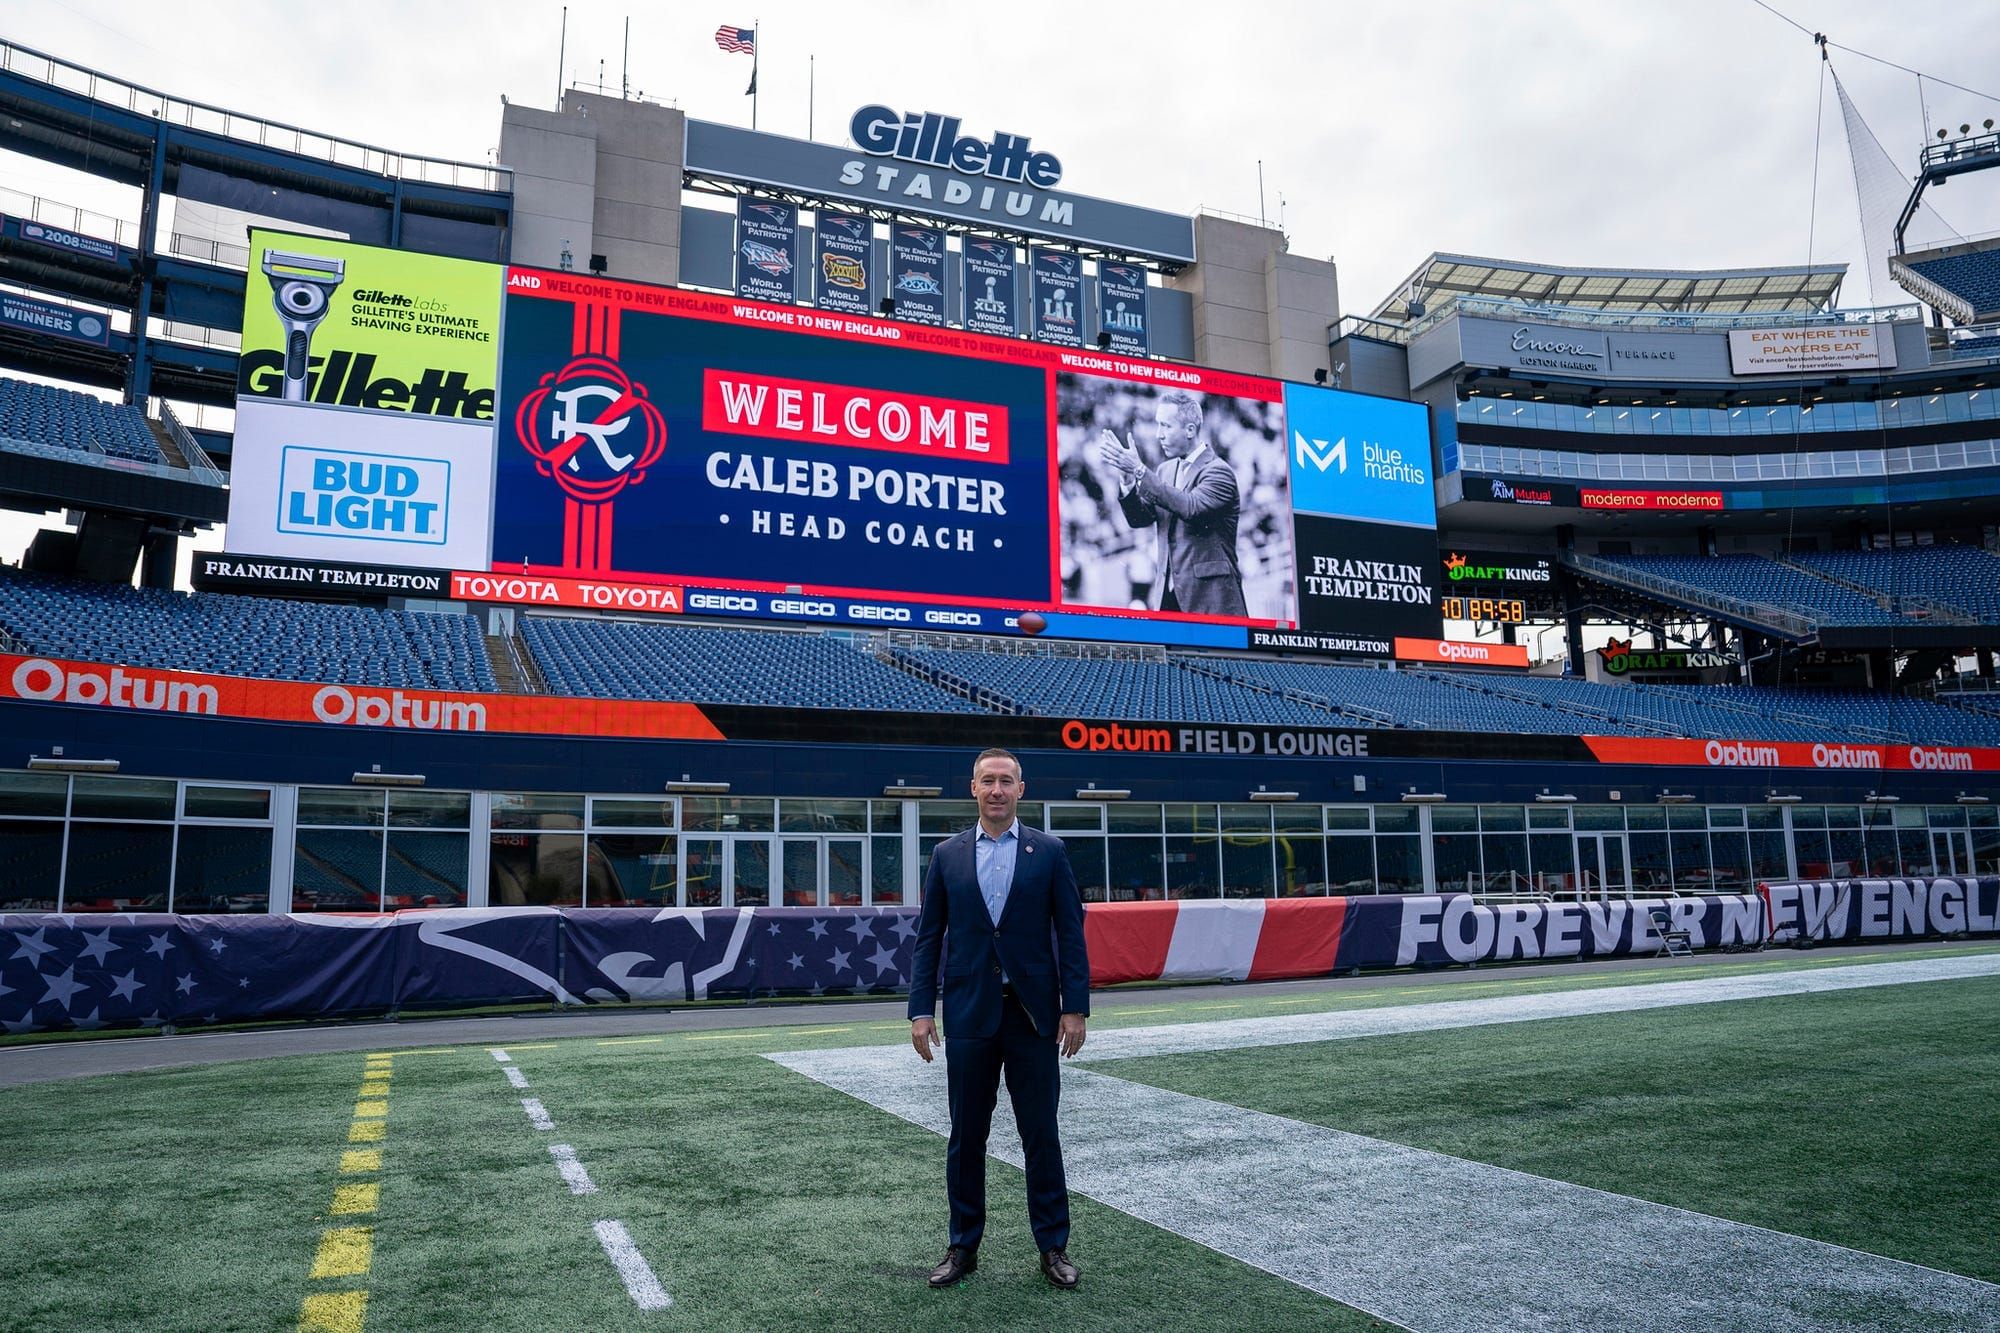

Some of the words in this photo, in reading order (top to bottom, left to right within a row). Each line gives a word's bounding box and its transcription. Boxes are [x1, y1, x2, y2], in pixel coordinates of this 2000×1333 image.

[849, 104, 1063, 189] Gillette
[839, 160, 1074, 226] STADIUM
[748, 227, 787, 240] PATRIOTS
[761, 222, 793, 234] ENGLAND
[45, 229, 80, 247] 2008
[820, 232, 837, 240] NEW
[838, 234, 869, 247] ENGLAND
[826, 240, 864, 253] PATRIOTS
[80, 244, 113, 256] CHAMPIONS
[900, 253, 937, 264] PATRIOTS
[912, 247, 942, 258] ENGLAND
[972, 265, 1007, 277] PATRIOTS
[983, 260, 1012, 271] ENGLAND
[750, 277, 782, 289] WORLD
[1035, 269, 1050, 277] NEW
[1052, 272, 1079, 282] ENGLAND
[1041, 277, 1075, 288] PATRIOTS
[546, 279, 612, 299] WELCOME
[615, 287, 632, 302] TO
[635, 292, 666, 306] NEW
[668, 295, 728, 315] ENGLAND
[740, 285, 792, 299] CHAMPIONS
[828, 289, 859, 301] WORLD
[1107, 288, 1139, 300] PATRIOTS
[1117, 283, 1144, 294] ENGLAND
[819, 297, 868, 311] CHAMPIONS
[903, 300, 933, 312] WORLD
[974, 301, 1007, 314] XLIX
[3, 306, 73, 331] WINNERS
[352, 304, 415, 320] GILLETTE'S
[420, 312, 479, 329] ULTIMATE
[733, 305, 794, 325] WELCOME
[796, 313, 814, 328] TO
[815, 317, 843, 332] NEW
[845, 321, 900, 339] ENGLAND
[895, 308, 942, 321] CHAMPIONS
[976, 312, 1005, 323] WORLD
[351, 317, 412, 333] SHAVING
[416, 324, 490, 342] EXPERIENCE
[968, 319, 1013, 333] CHAMPIONS
[1045, 323, 1073, 334] WORLD
[1037, 330, 1081, 343] CHAMPIONS
[1111, 334, 1138, 345] WORLD
[1512, 326, 1603, 358] Encore
[1752, 332, 1779, 342] EAT
[1781, 330, 1836, 340] WHERE
[1839, 328, 1870, 337] THE
[905, 330, 961, 348] WELCOME
[962, 338, 978, 351] TO
[979, 342, 1005, 355] NEW
[1007, 345, 1058, 363] ENGLAND
[1109, 342, 1146, 353] HAMPIONS
[1615, 350, 1676, 360] TERRACE
[1762, 344, 1831, 354] PLAYERS
[1834, 342, 1861, 352] EAT
[1061, 353, 1112, 372] WELCOME
[1114, 361, 1128, 374] TO
[1130, 364, 1153, 378] NEW
[1155, 369, 1201, 385] ENGLAND
[1520, 356, 1557, 368] BOSTON
[1560, 360, 1598, 371] HARBOR
[238, 349, 495, 421] Gillette
[1205, 377, 1250, 393] WELCOME
[1252, 381, 1264, 394] TO
[718, 380, 991, 453] WELCOME
[1362, 440, 1402, 465] blue
[313, 458, 419, 498] BUD
[1364, 462, 1425, 485] mantis
[706, 451, 839, 498] CALEB
[848, 465, 1007, 516] PORTER
[1493, 487, 1515, 499] AIM
[1515, 488, 1551, 500] Mutual
[1584, 492, 1645, 506] moderna
[1656, 493, 1719, 507] moderna
[289, 490, 438, 534] LIGHT
[752, 509, 846, 541] HEAD
[865, 520, 975, 552] COACH
[204, 560, 315, 582] FRANKLIN
[319, 568, 441, 592] TEMPLETON
[1312, 555, 1422, 584] FRANKLIN
[1449, 565, 1550, 582] DRAFTKINGS
[455, 576, 560, 602] TOYOTA
[578, 584, 678, 609] TOYOTA
[1305, 576, 1432, 605] TEMPLETON
[690, 593, 757, 612] GEICO
[770, 599, 835, 617] GEICO
[1470, 600, 1522, 622] 89:58
[848, 605, 911, 622] GEICO
[925, 610, 981, 626] GEICO
[1254, 633, 1317, 649] FRANKLIN
[1320, 638, 1389, 653] TEMPLETON
[1438, 641, 1488, 660] Optum
[12, 658, 218, 715] Optum
[312, 685, 486, 731] Optum
[1062, 720, 1171, 752] Optum
[1179, 729, 1255, 753] FIELD
[1264, 732, 1369, 756] LOUNGE
[1705, 740, 1779, 767] Optum
[1812, 743, 1880, 769] Optum
[1910, 747, 1973, 771] Optum
[1396, 895, 1706, 967] FOREVER
[1862, 877, 2000, 941] ENGL
